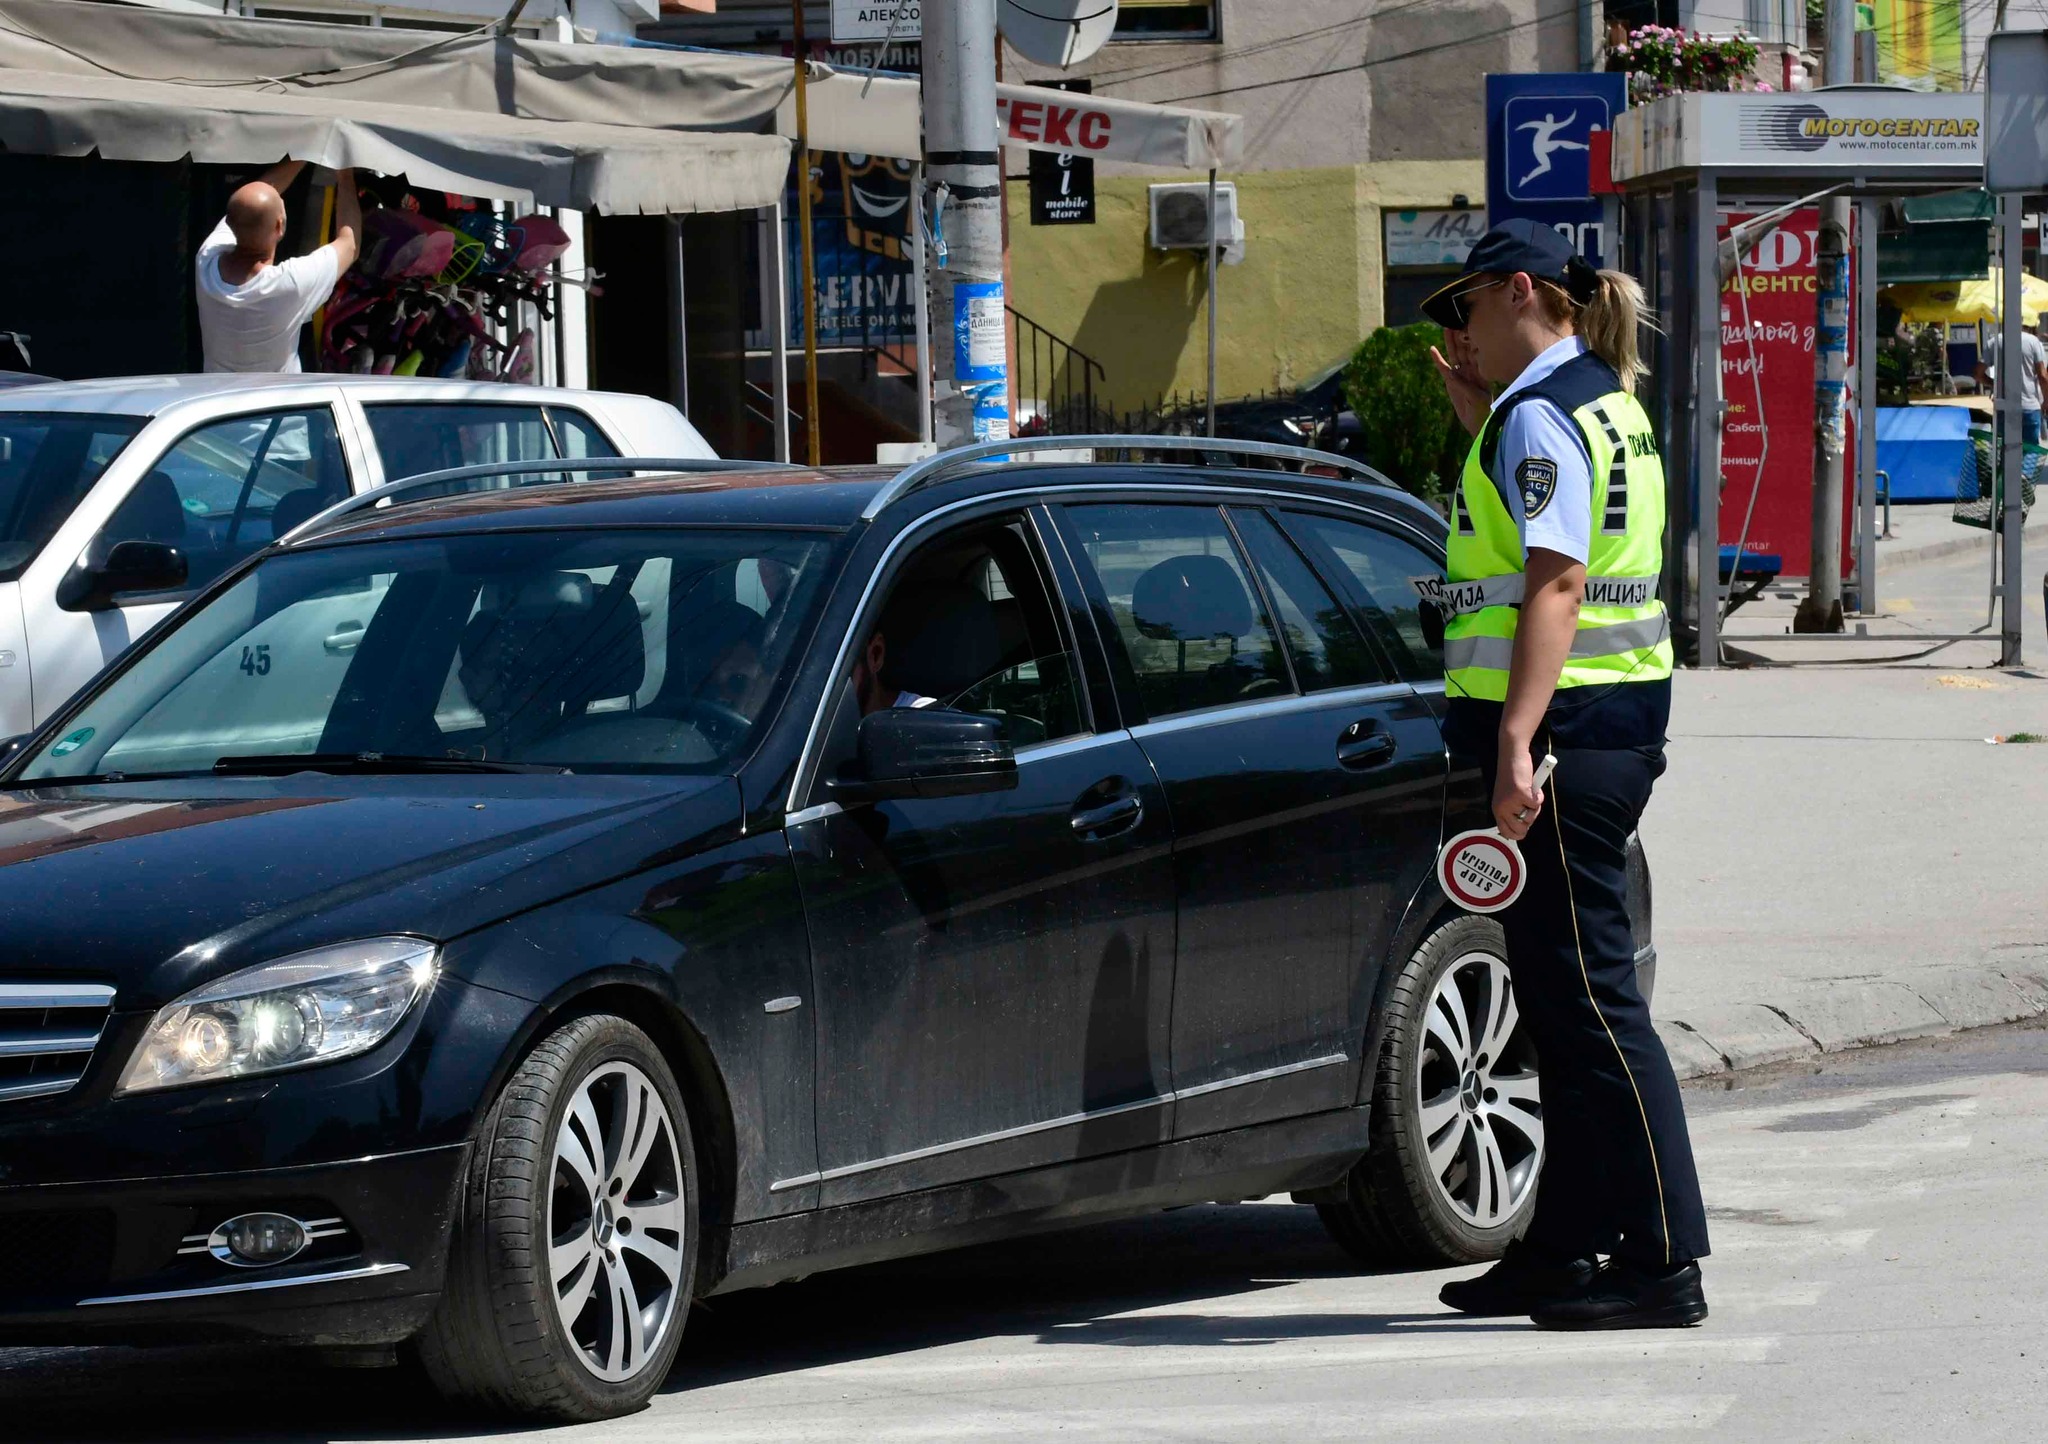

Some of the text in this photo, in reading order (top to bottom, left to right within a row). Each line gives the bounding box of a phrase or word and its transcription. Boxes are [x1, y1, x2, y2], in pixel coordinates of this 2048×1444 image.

[1804, 118, 1980, 138] MOTOCENTAR
[1839, 140, 1978, 150] www.motocentar.com.mk
[1045, 196, 1088, 209] mobile
[1050, 208, 1081, 219] store
[240, 644, 271, 676] 45
[1461, 850, 1509, 884] POLICIJA
[1460, 869, 1493, 892] STOP
